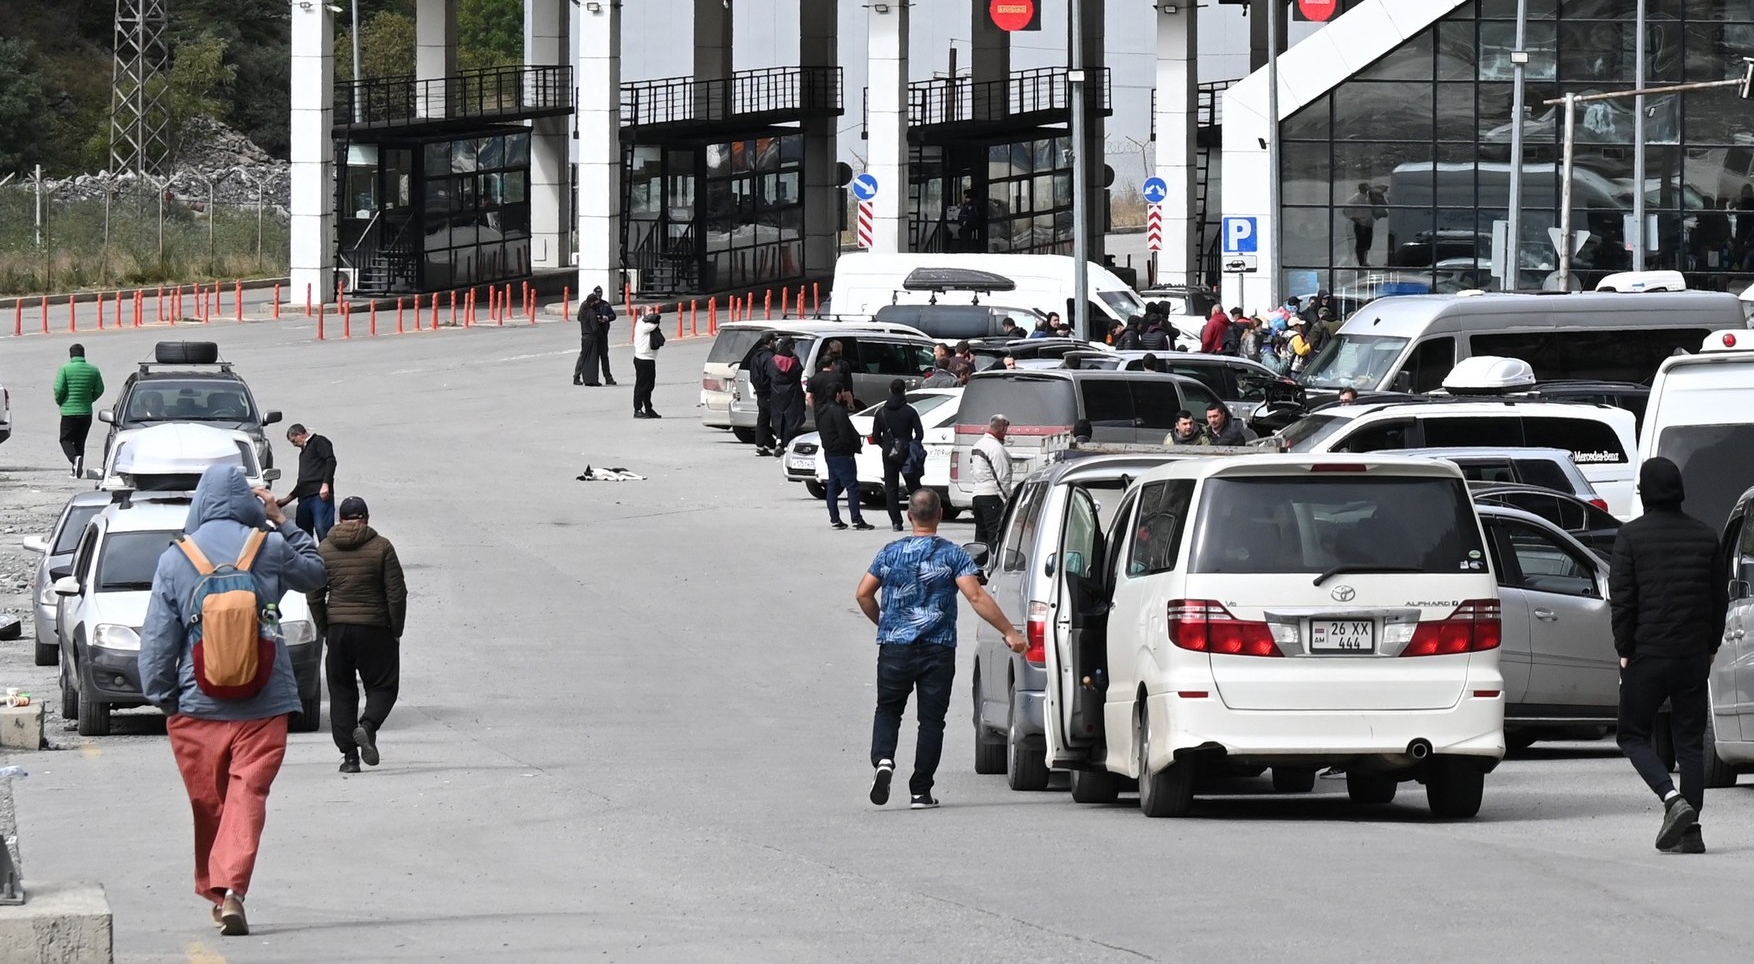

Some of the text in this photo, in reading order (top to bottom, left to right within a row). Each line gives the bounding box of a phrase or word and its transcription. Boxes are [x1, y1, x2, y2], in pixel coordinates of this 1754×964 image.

[1228, 218, 1252, 251] P
[1574, 450, 1619, 462] Mercedes-Benz
[1331, 622, 1369, 636] 26 XX
[1338, 636, 1361, 650] 444
